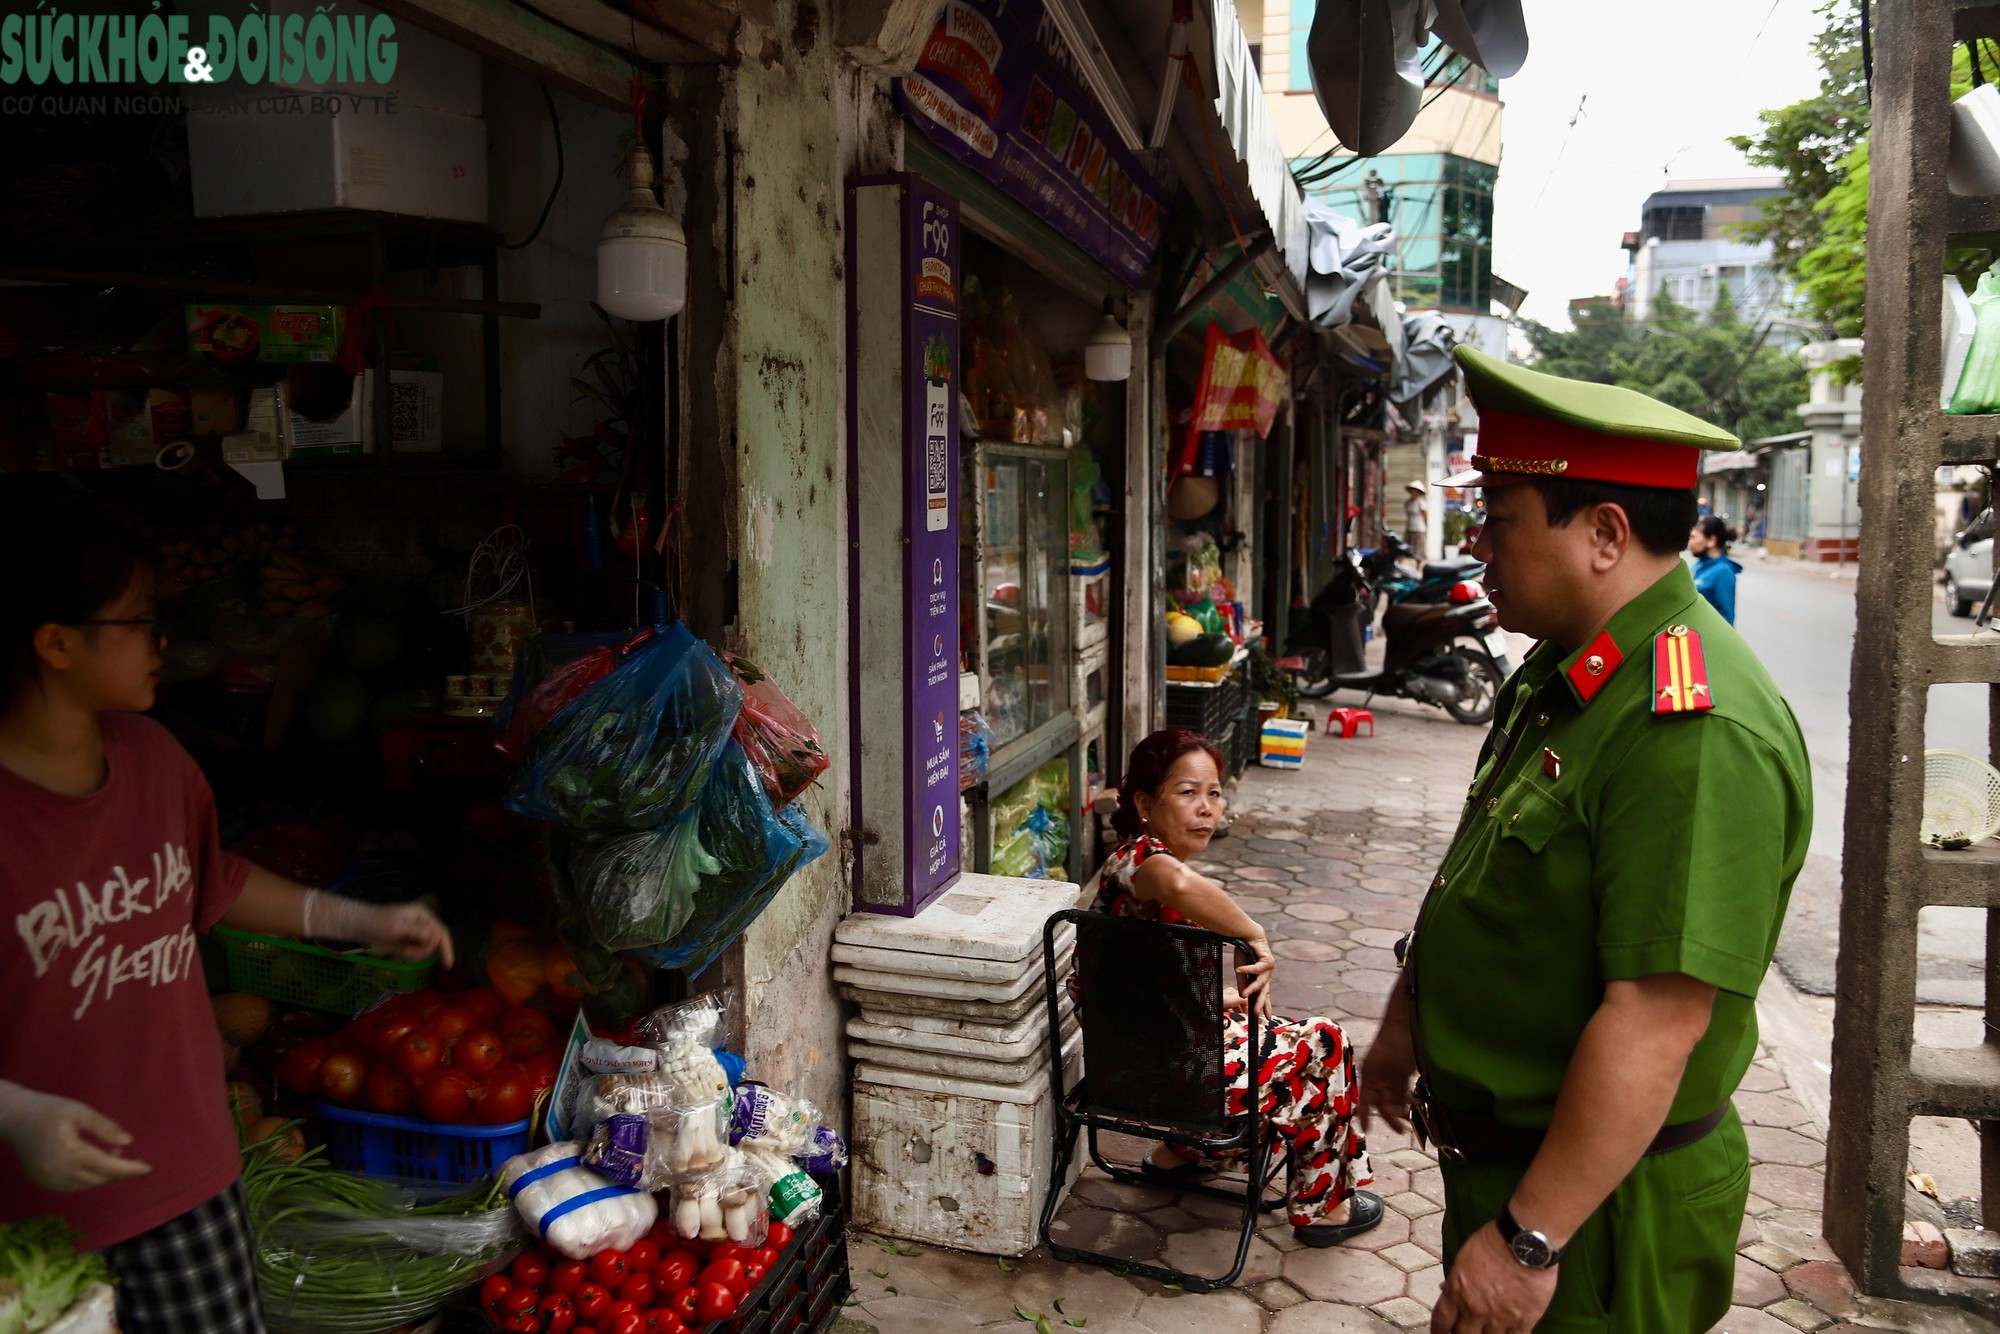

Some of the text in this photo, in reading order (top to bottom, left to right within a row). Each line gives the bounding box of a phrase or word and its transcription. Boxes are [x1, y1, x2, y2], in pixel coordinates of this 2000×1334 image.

[954, 7, 998, 63] FARMTECH
[907, 76, 927, 102] NHẬP
[926, 754, 938, 771] MUA
[927, 765, 949, 788] HIỆN ĐẠI
[929, 834, 947, 859] GIÁ CẢ
[929, 858, 941, 876] HỢP
[15, 864, 153, 980] BLACK
[70, 922, 197, 1022] SKETCH
